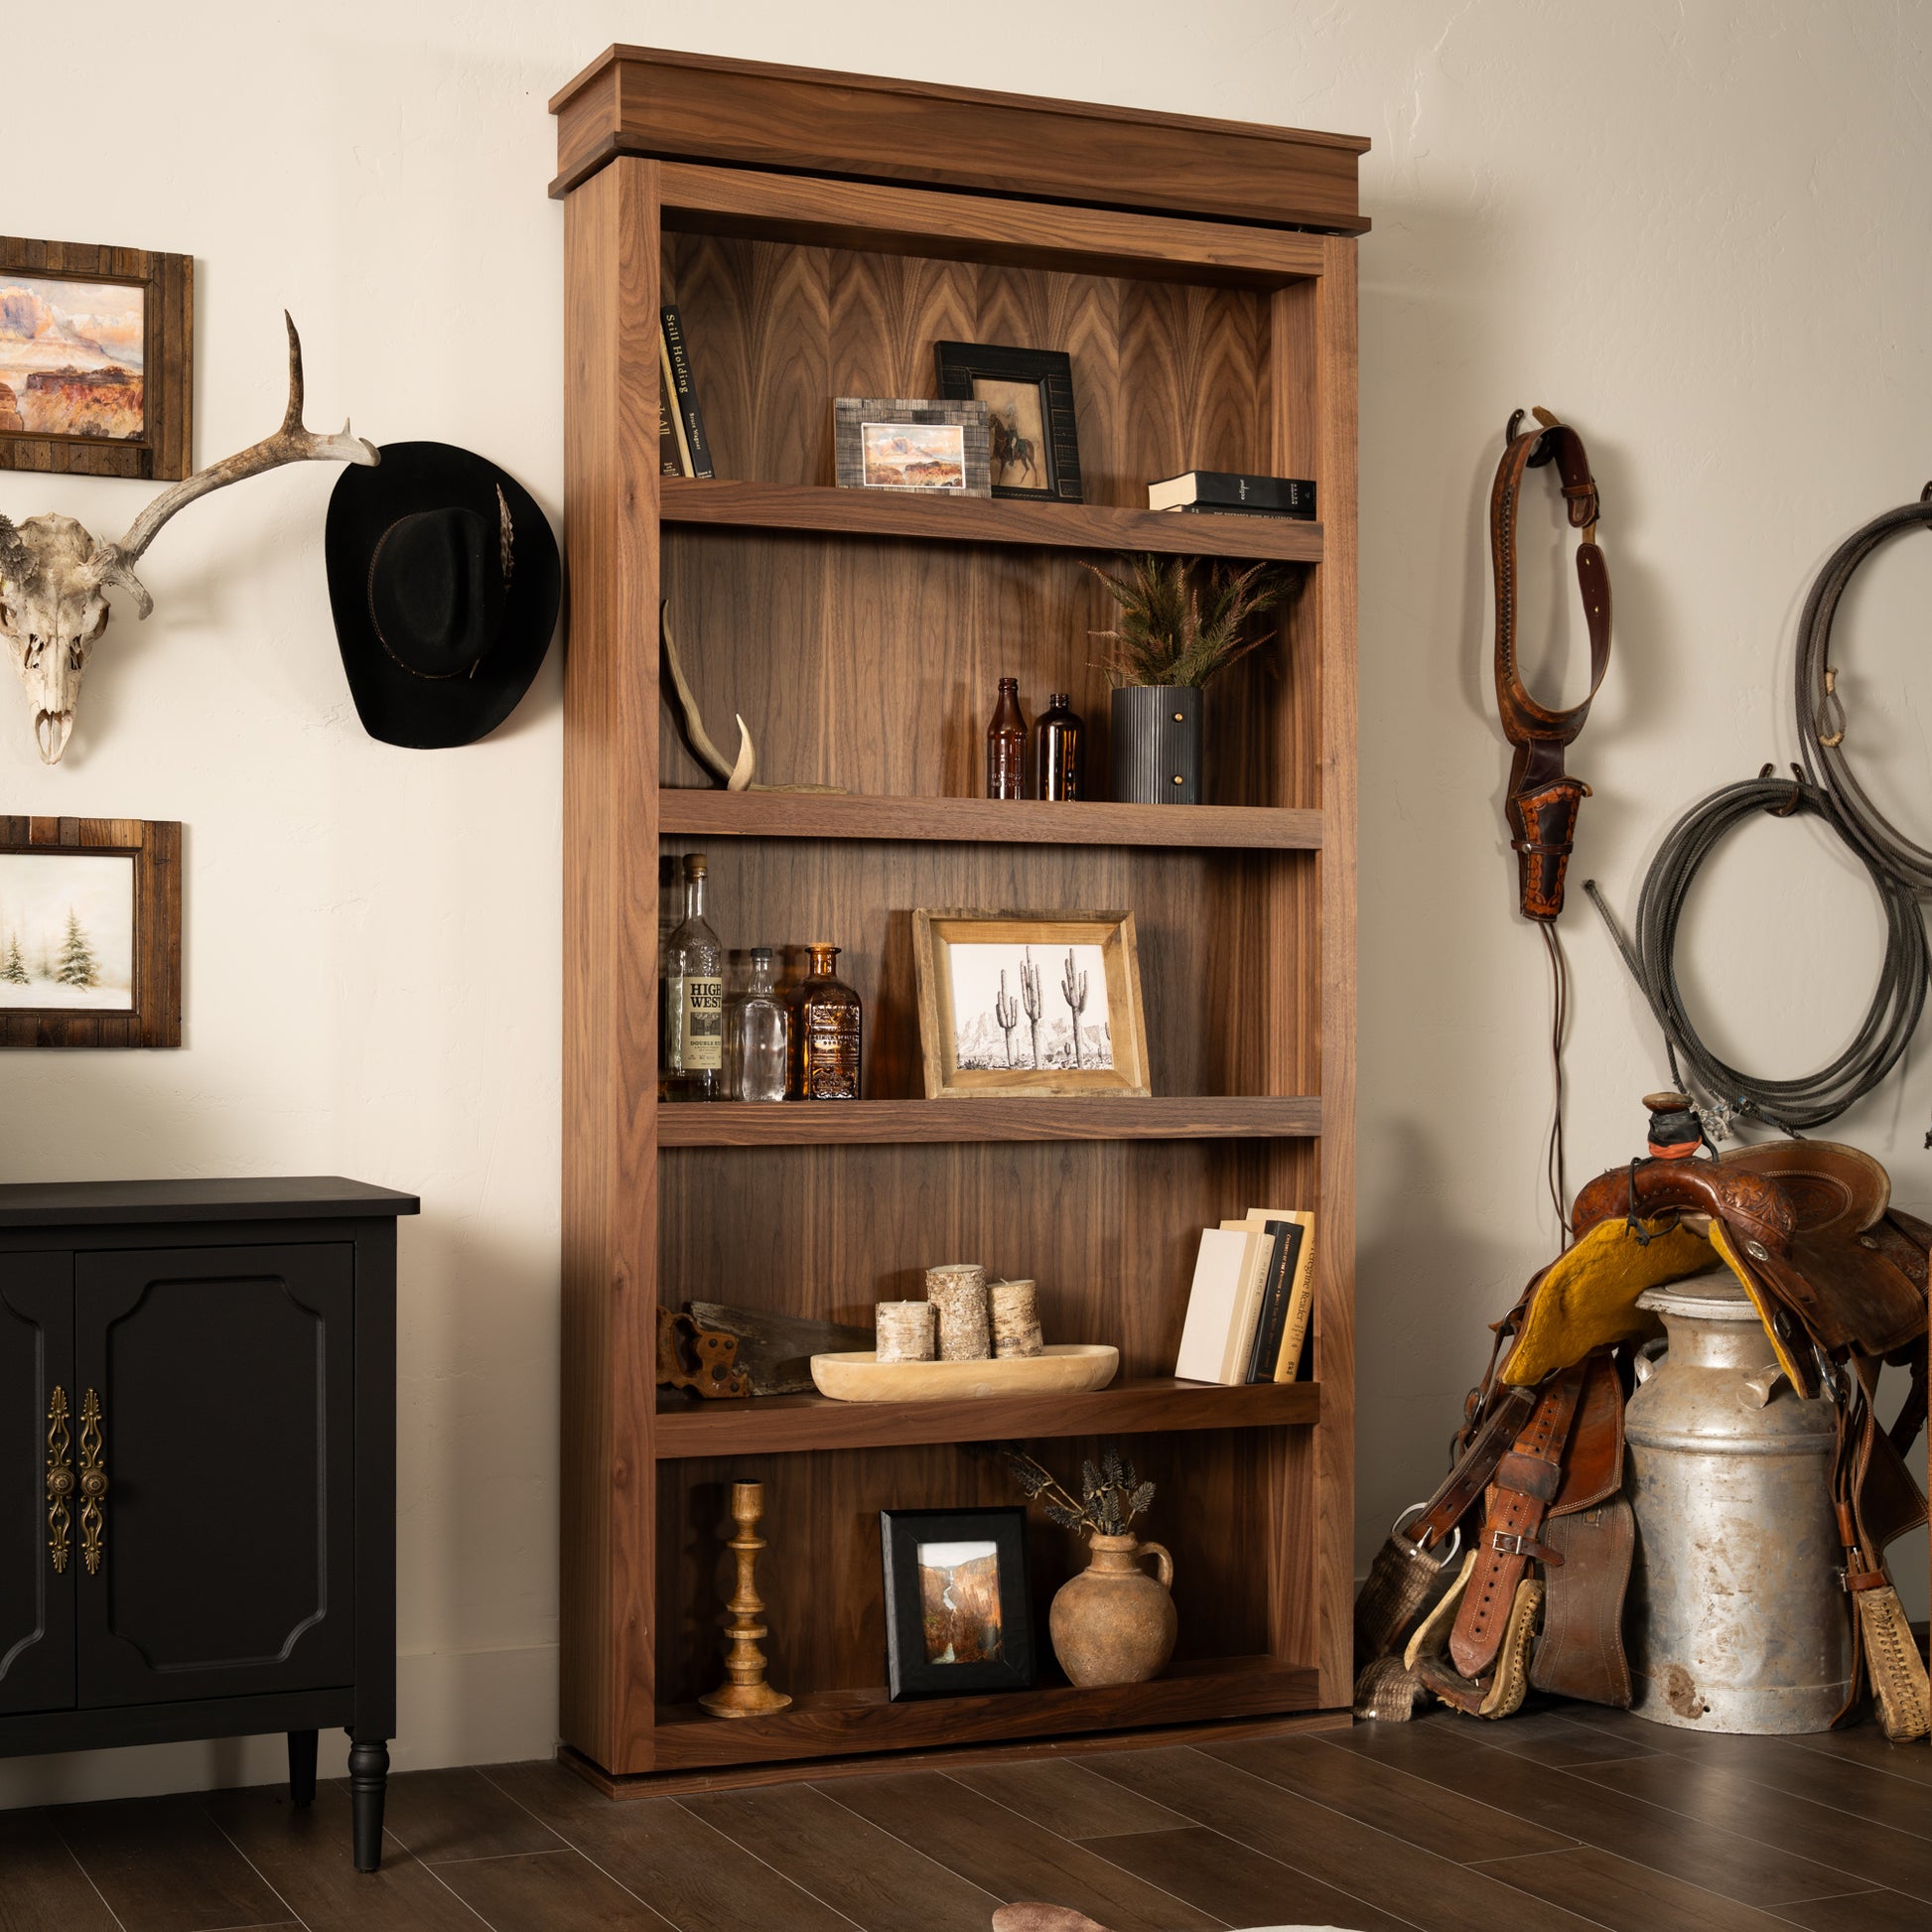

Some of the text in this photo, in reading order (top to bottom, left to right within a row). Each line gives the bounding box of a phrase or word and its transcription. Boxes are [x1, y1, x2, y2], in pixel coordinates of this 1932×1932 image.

[666, 314, 689, 393] Still Holding
[690, 983, 722, 996] HIGH
[690, 996, 722, 1008] WEST
[1304, 1247, 1315, 1290] eregrine
[1298, 1291, 1311, 1321] Reader
